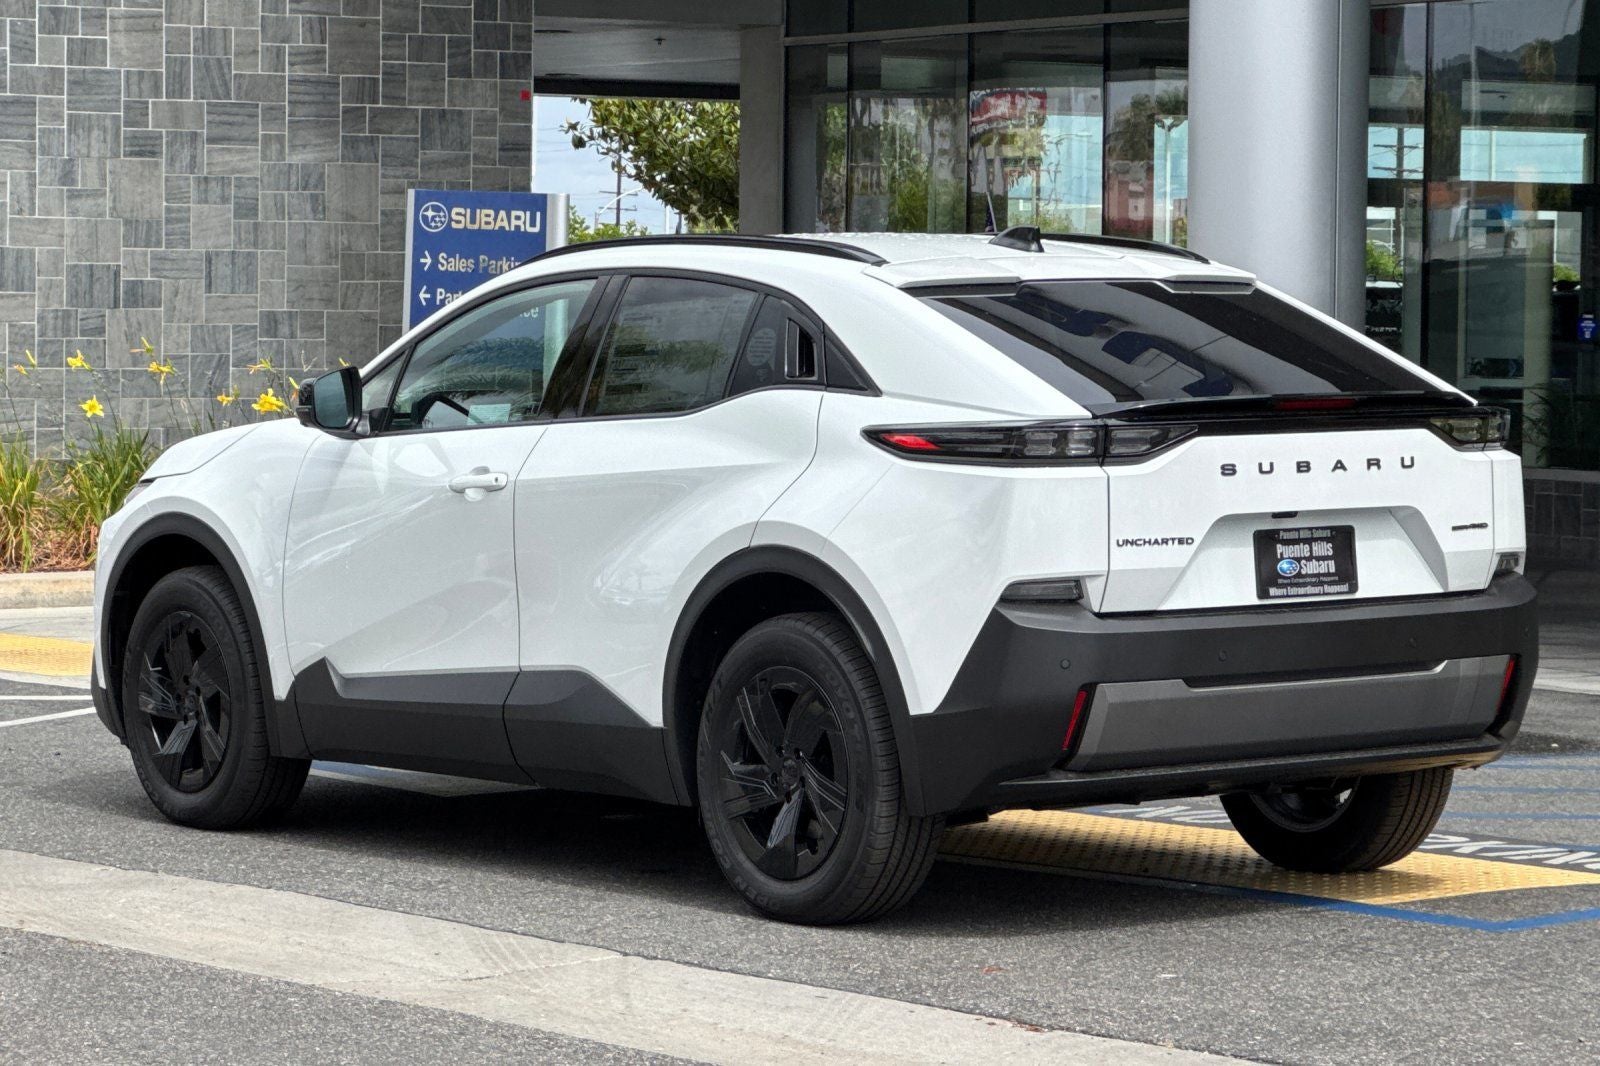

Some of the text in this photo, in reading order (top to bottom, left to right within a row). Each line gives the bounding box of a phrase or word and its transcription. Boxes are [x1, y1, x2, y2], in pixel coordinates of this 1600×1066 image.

[451, 207, 541, 233] SUBARU
[438, 252, 521, 275] Sales Parki
[1220, 456, 1416, 477] SUBARU
[1116, 537, 1195, 547] UNCHARTED
[1276, 541, 1333, 558] Puente Hills
[1300, 559, 1336, 574] Subaru
